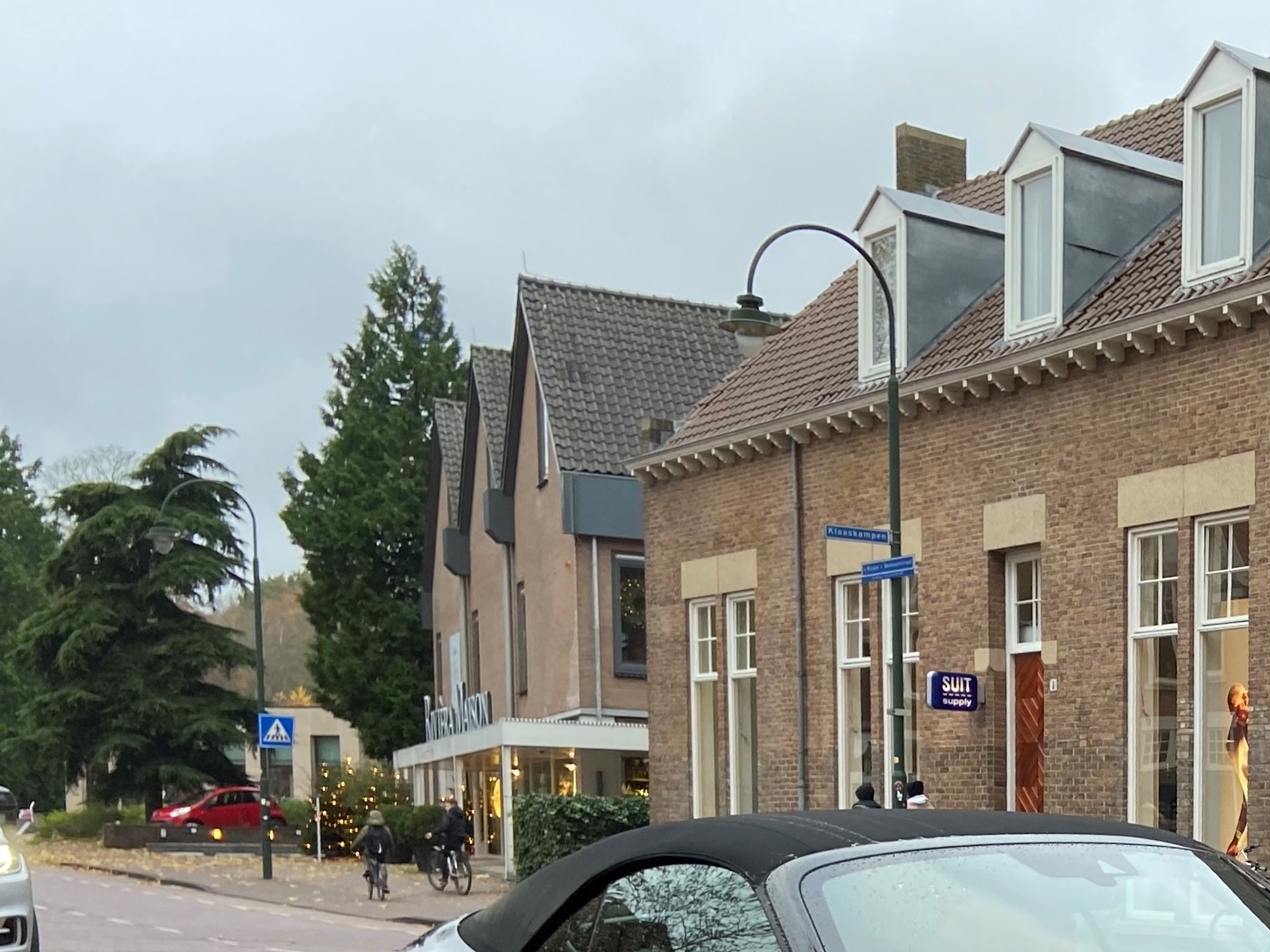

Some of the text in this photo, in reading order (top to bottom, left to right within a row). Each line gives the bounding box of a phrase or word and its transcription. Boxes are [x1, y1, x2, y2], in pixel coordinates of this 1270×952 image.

[827, 526, 887, 540] Klaaskampen
[942, 676, 972, 693] SUIT
[942, 698, 972, 707] supply
